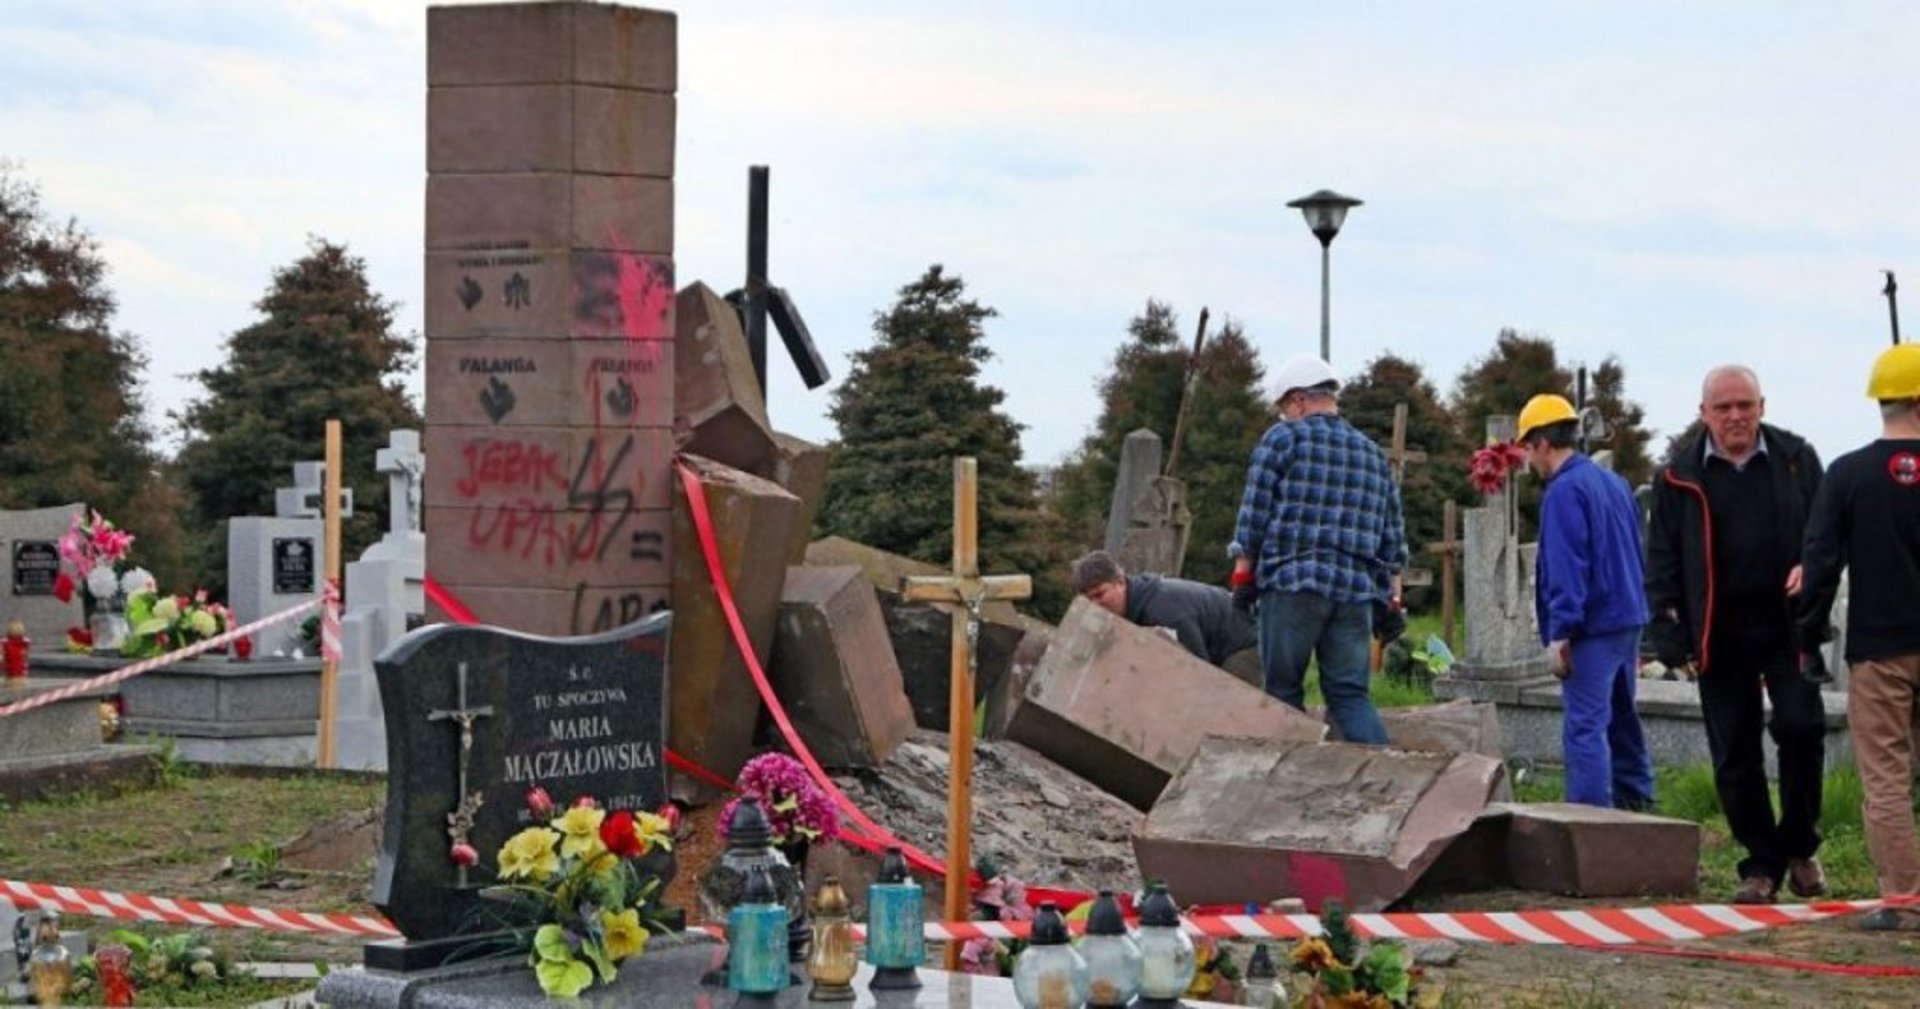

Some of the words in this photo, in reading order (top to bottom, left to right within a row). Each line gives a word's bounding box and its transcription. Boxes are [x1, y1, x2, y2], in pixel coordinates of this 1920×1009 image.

[534, 695, 552, 710] TU
[558, 688, 627, 708] SPOCZYWA
[549, 716, 612, 741] MARIA
